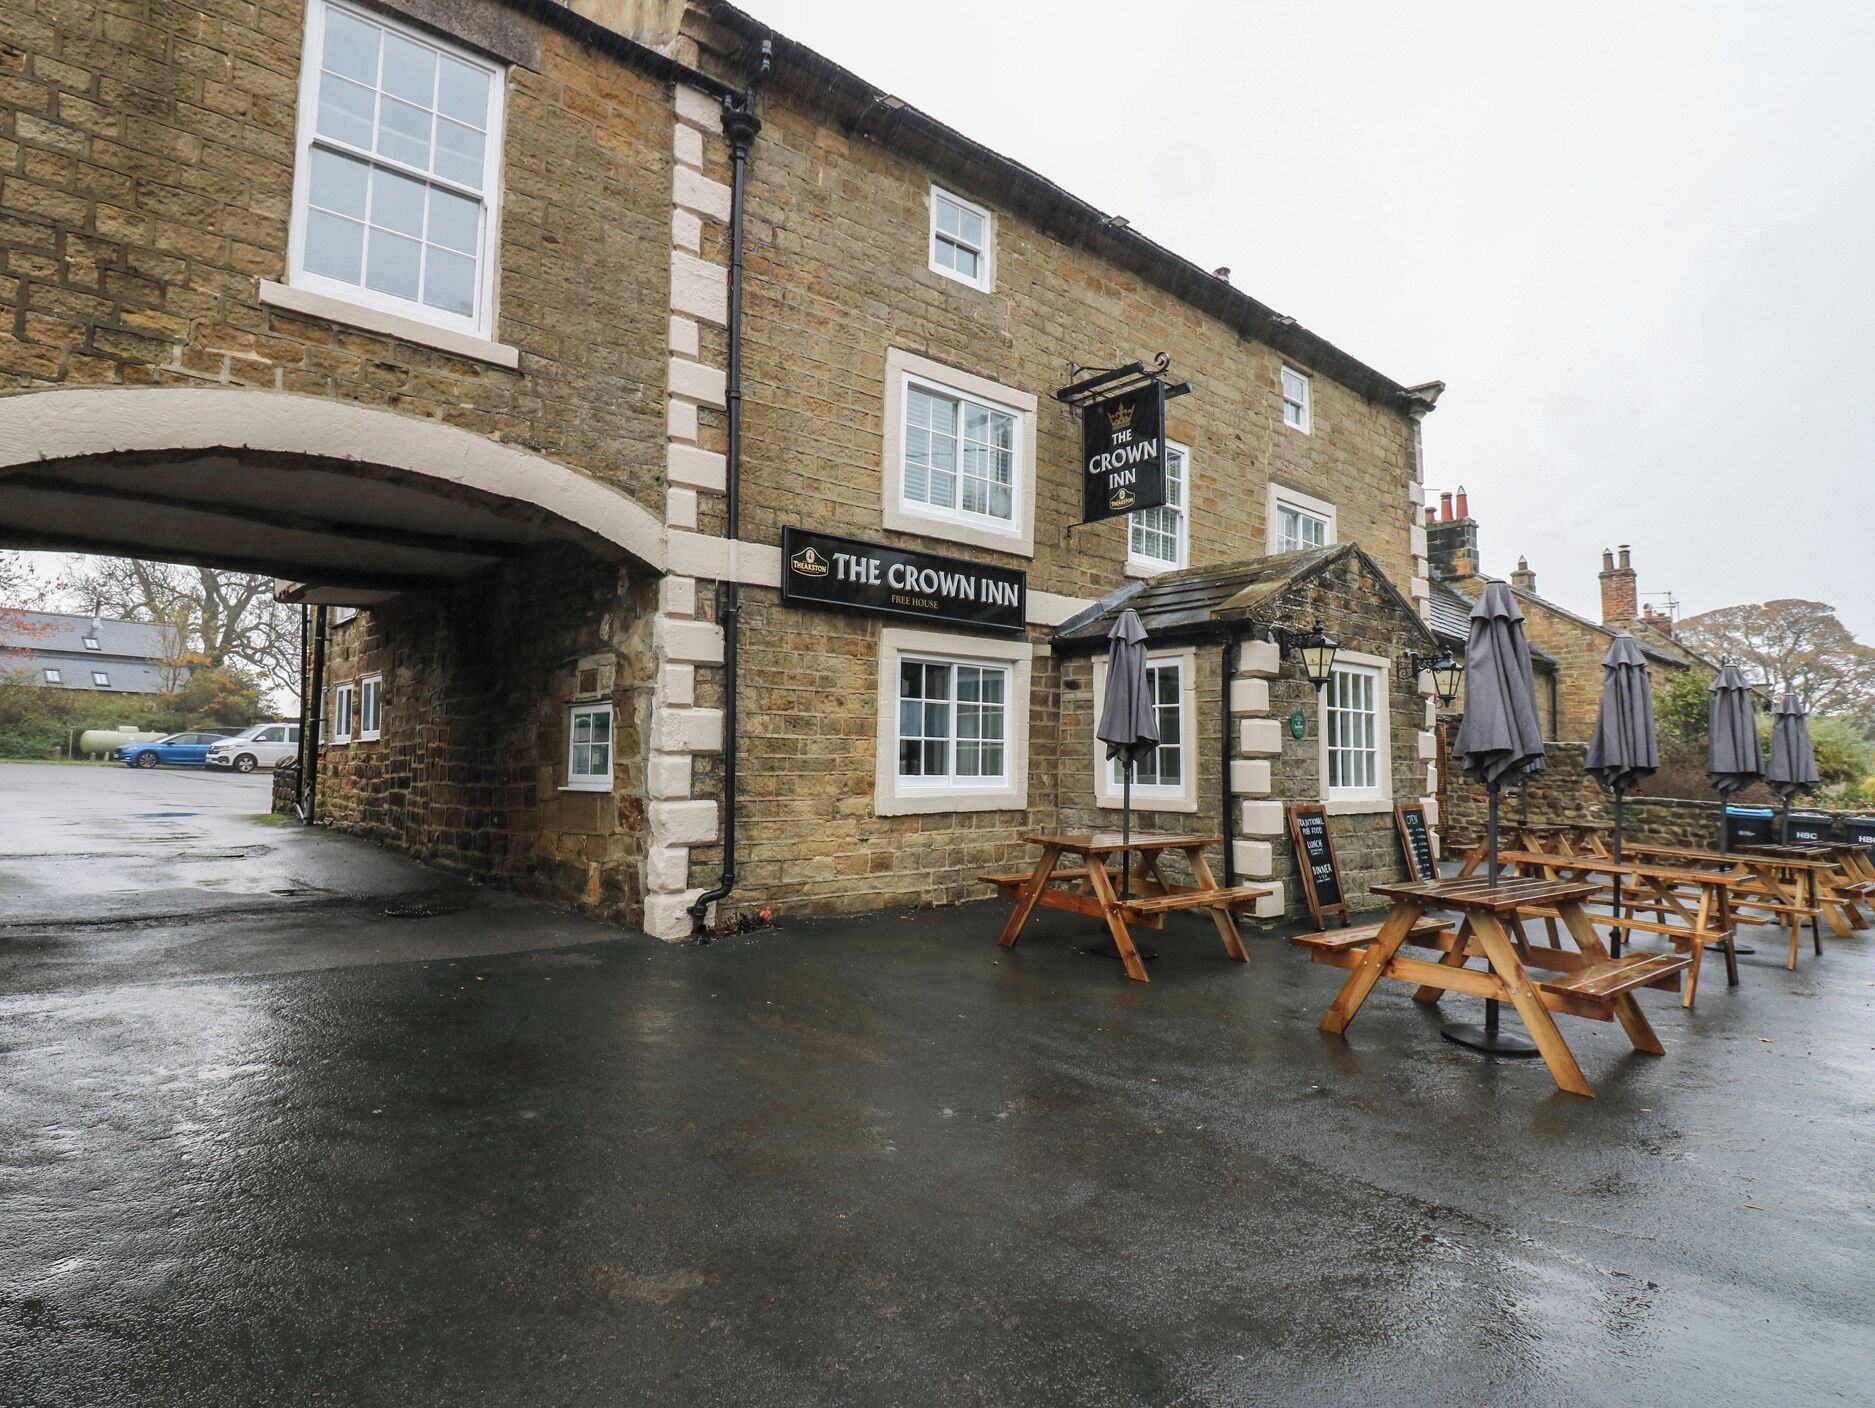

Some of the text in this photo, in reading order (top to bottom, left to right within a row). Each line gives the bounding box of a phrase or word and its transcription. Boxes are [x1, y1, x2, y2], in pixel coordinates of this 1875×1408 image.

[1111, 428, 1133, 446] THE
[1089, 438, 1157, 474] CROWN
[1109, 468, 1136, 489] INN
[793, 560, 826, 573] THEAKSTON
[832, 552, 1019, 607] THE CROWN INN
[891, 594, 939, 609] FREE HOUSE
[1297, 817, 1325, 827] TRADITIONAL
[1302, 826, 1322, 835] PUB FOOD
[1796, 832, 1818, 840] HBC
[1306, 839, 1323, 849] LUNCH
[1312, 863, 1333, 875] DINNER
